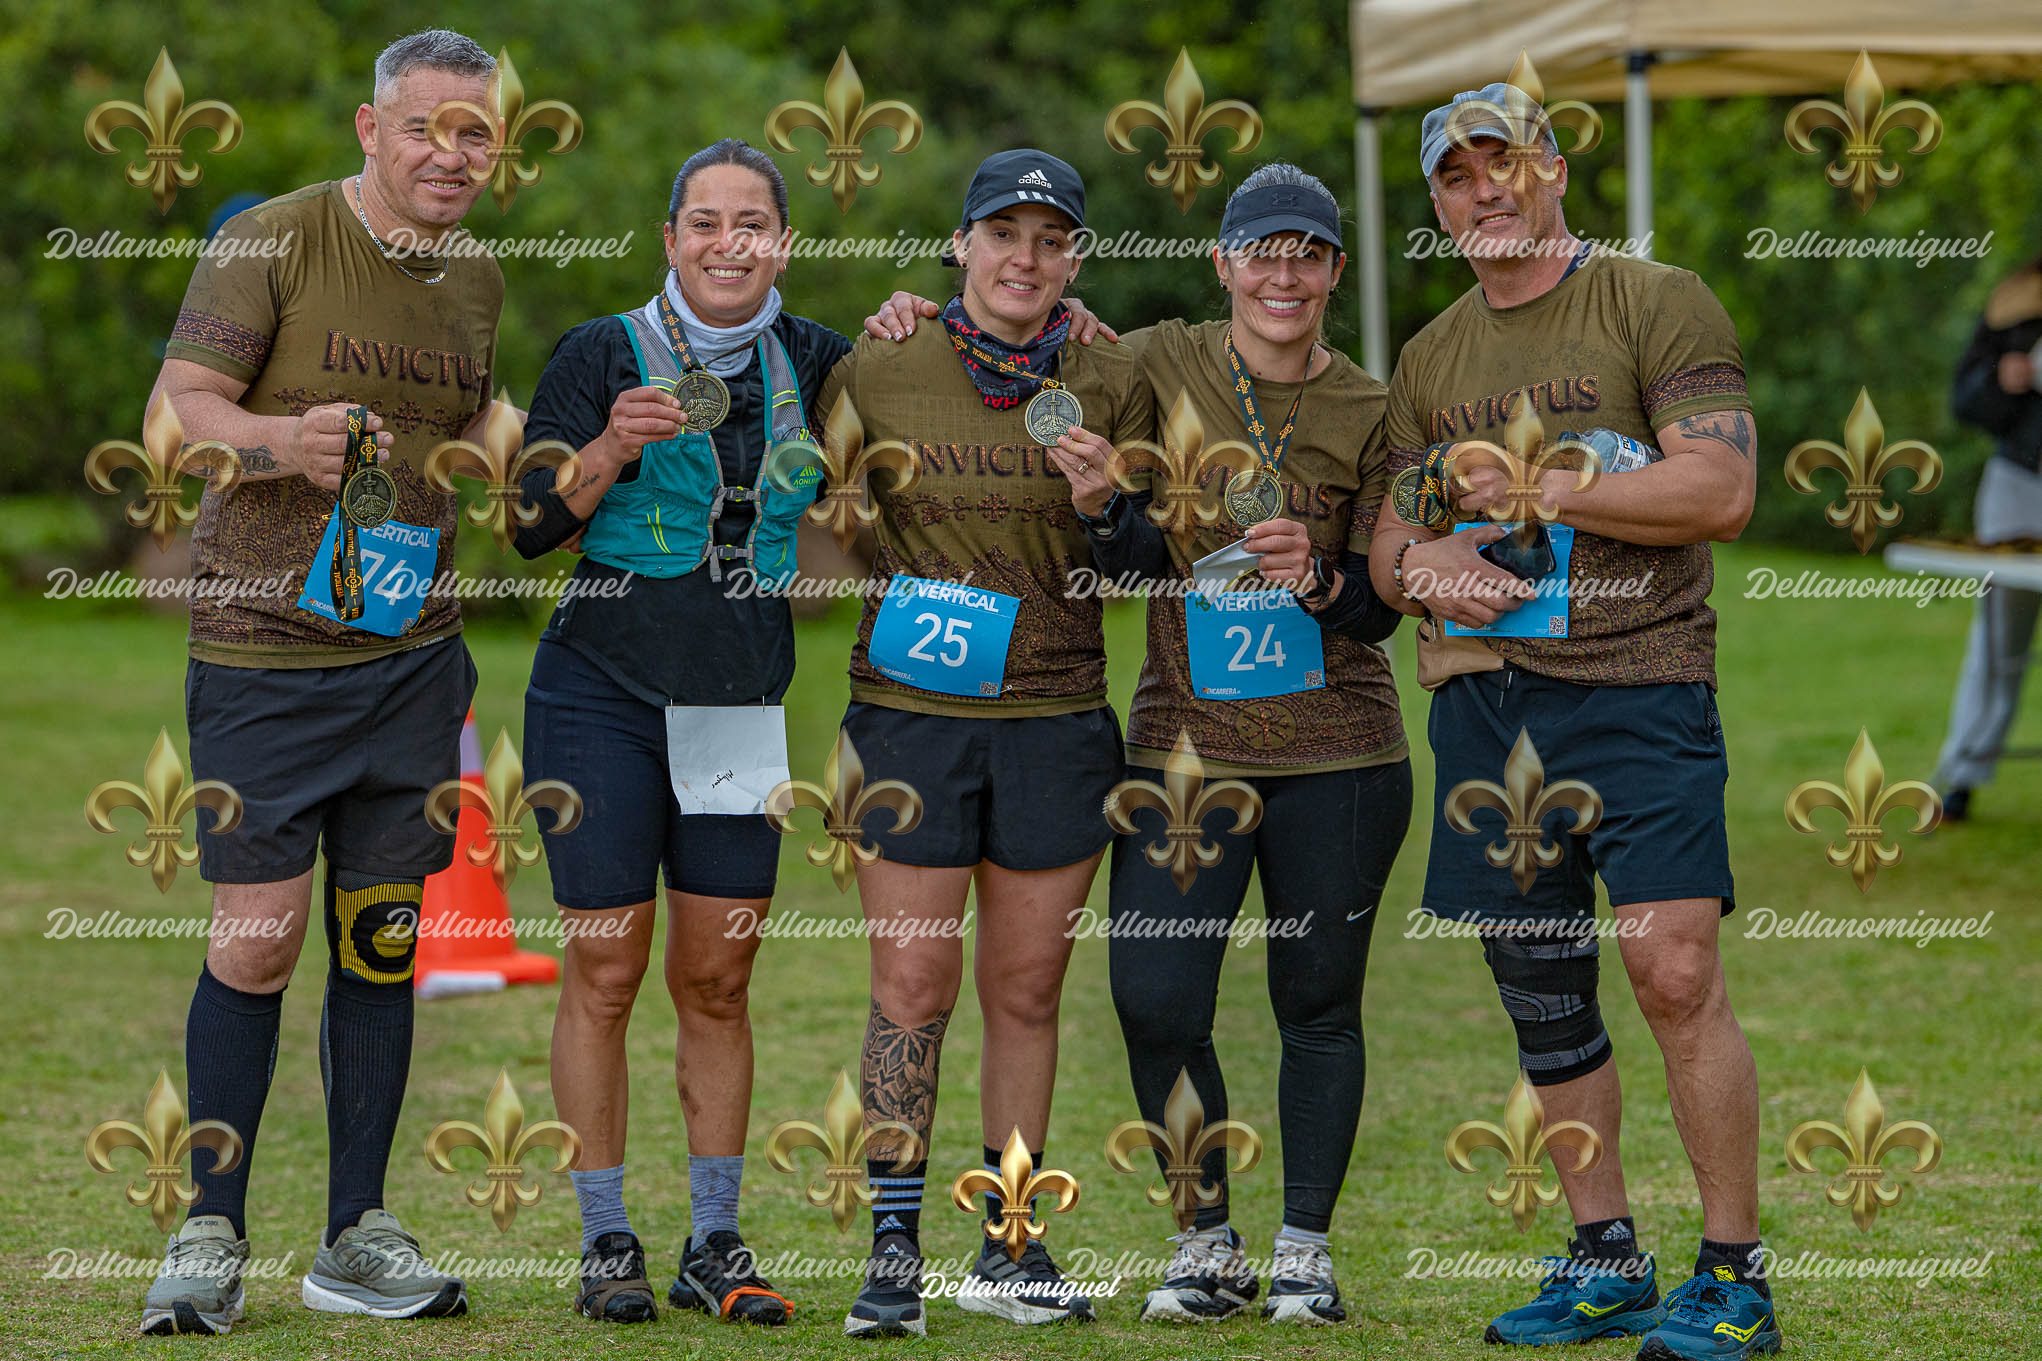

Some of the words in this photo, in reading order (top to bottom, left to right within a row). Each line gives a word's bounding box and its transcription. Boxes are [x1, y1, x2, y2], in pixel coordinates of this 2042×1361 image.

[1018, 177, 1052, 189] adidas
[1430, 374, 1601, 440] INVICTUS
[918, 582, 999, 613] VERTICAL
[907, 612, 973, 667] 25
[1224, 623, 1287, 672] 24
